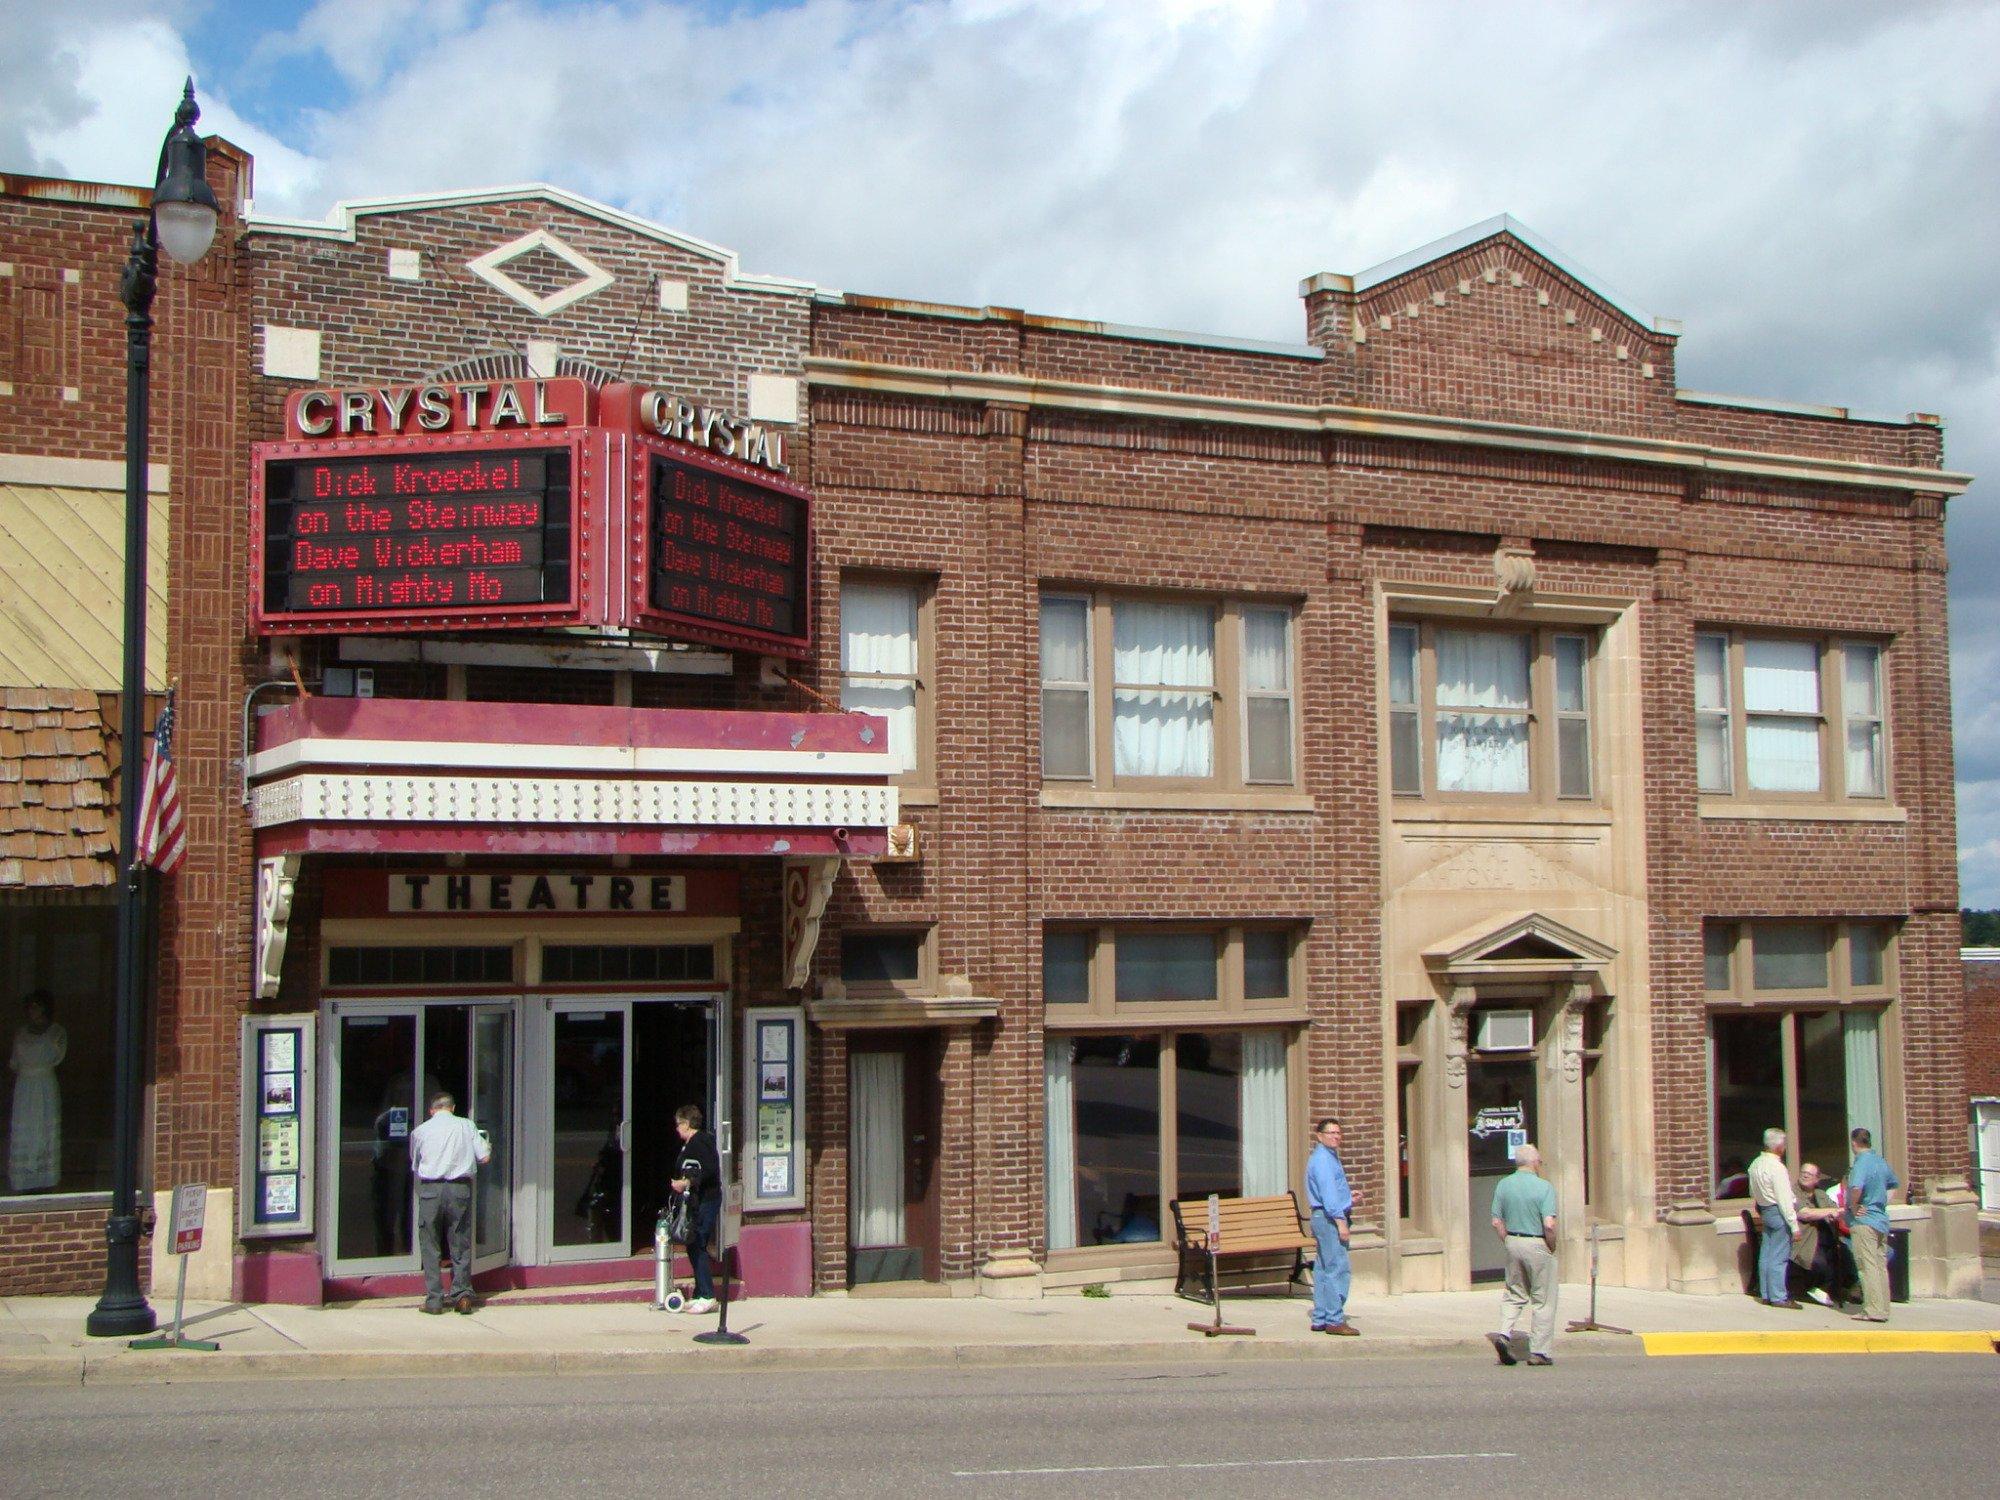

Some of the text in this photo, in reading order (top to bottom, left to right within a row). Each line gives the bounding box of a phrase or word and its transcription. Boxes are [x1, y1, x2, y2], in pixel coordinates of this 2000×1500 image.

[297, 380, 566, 435] CRYSTAL
[641, 390, 790, 474] CRYSTAL
[314, 458, 521, 497] Dick Kroeckel
[296, 500, 538, 534] on the Steinway
[295, 535, 522, 570] Dave Vickerham
[309, 571, 502, 606] on Mighty Mo
[405, 875, 673, 910] THEATRE
[177, 1239, 201, 1251] PARKING
